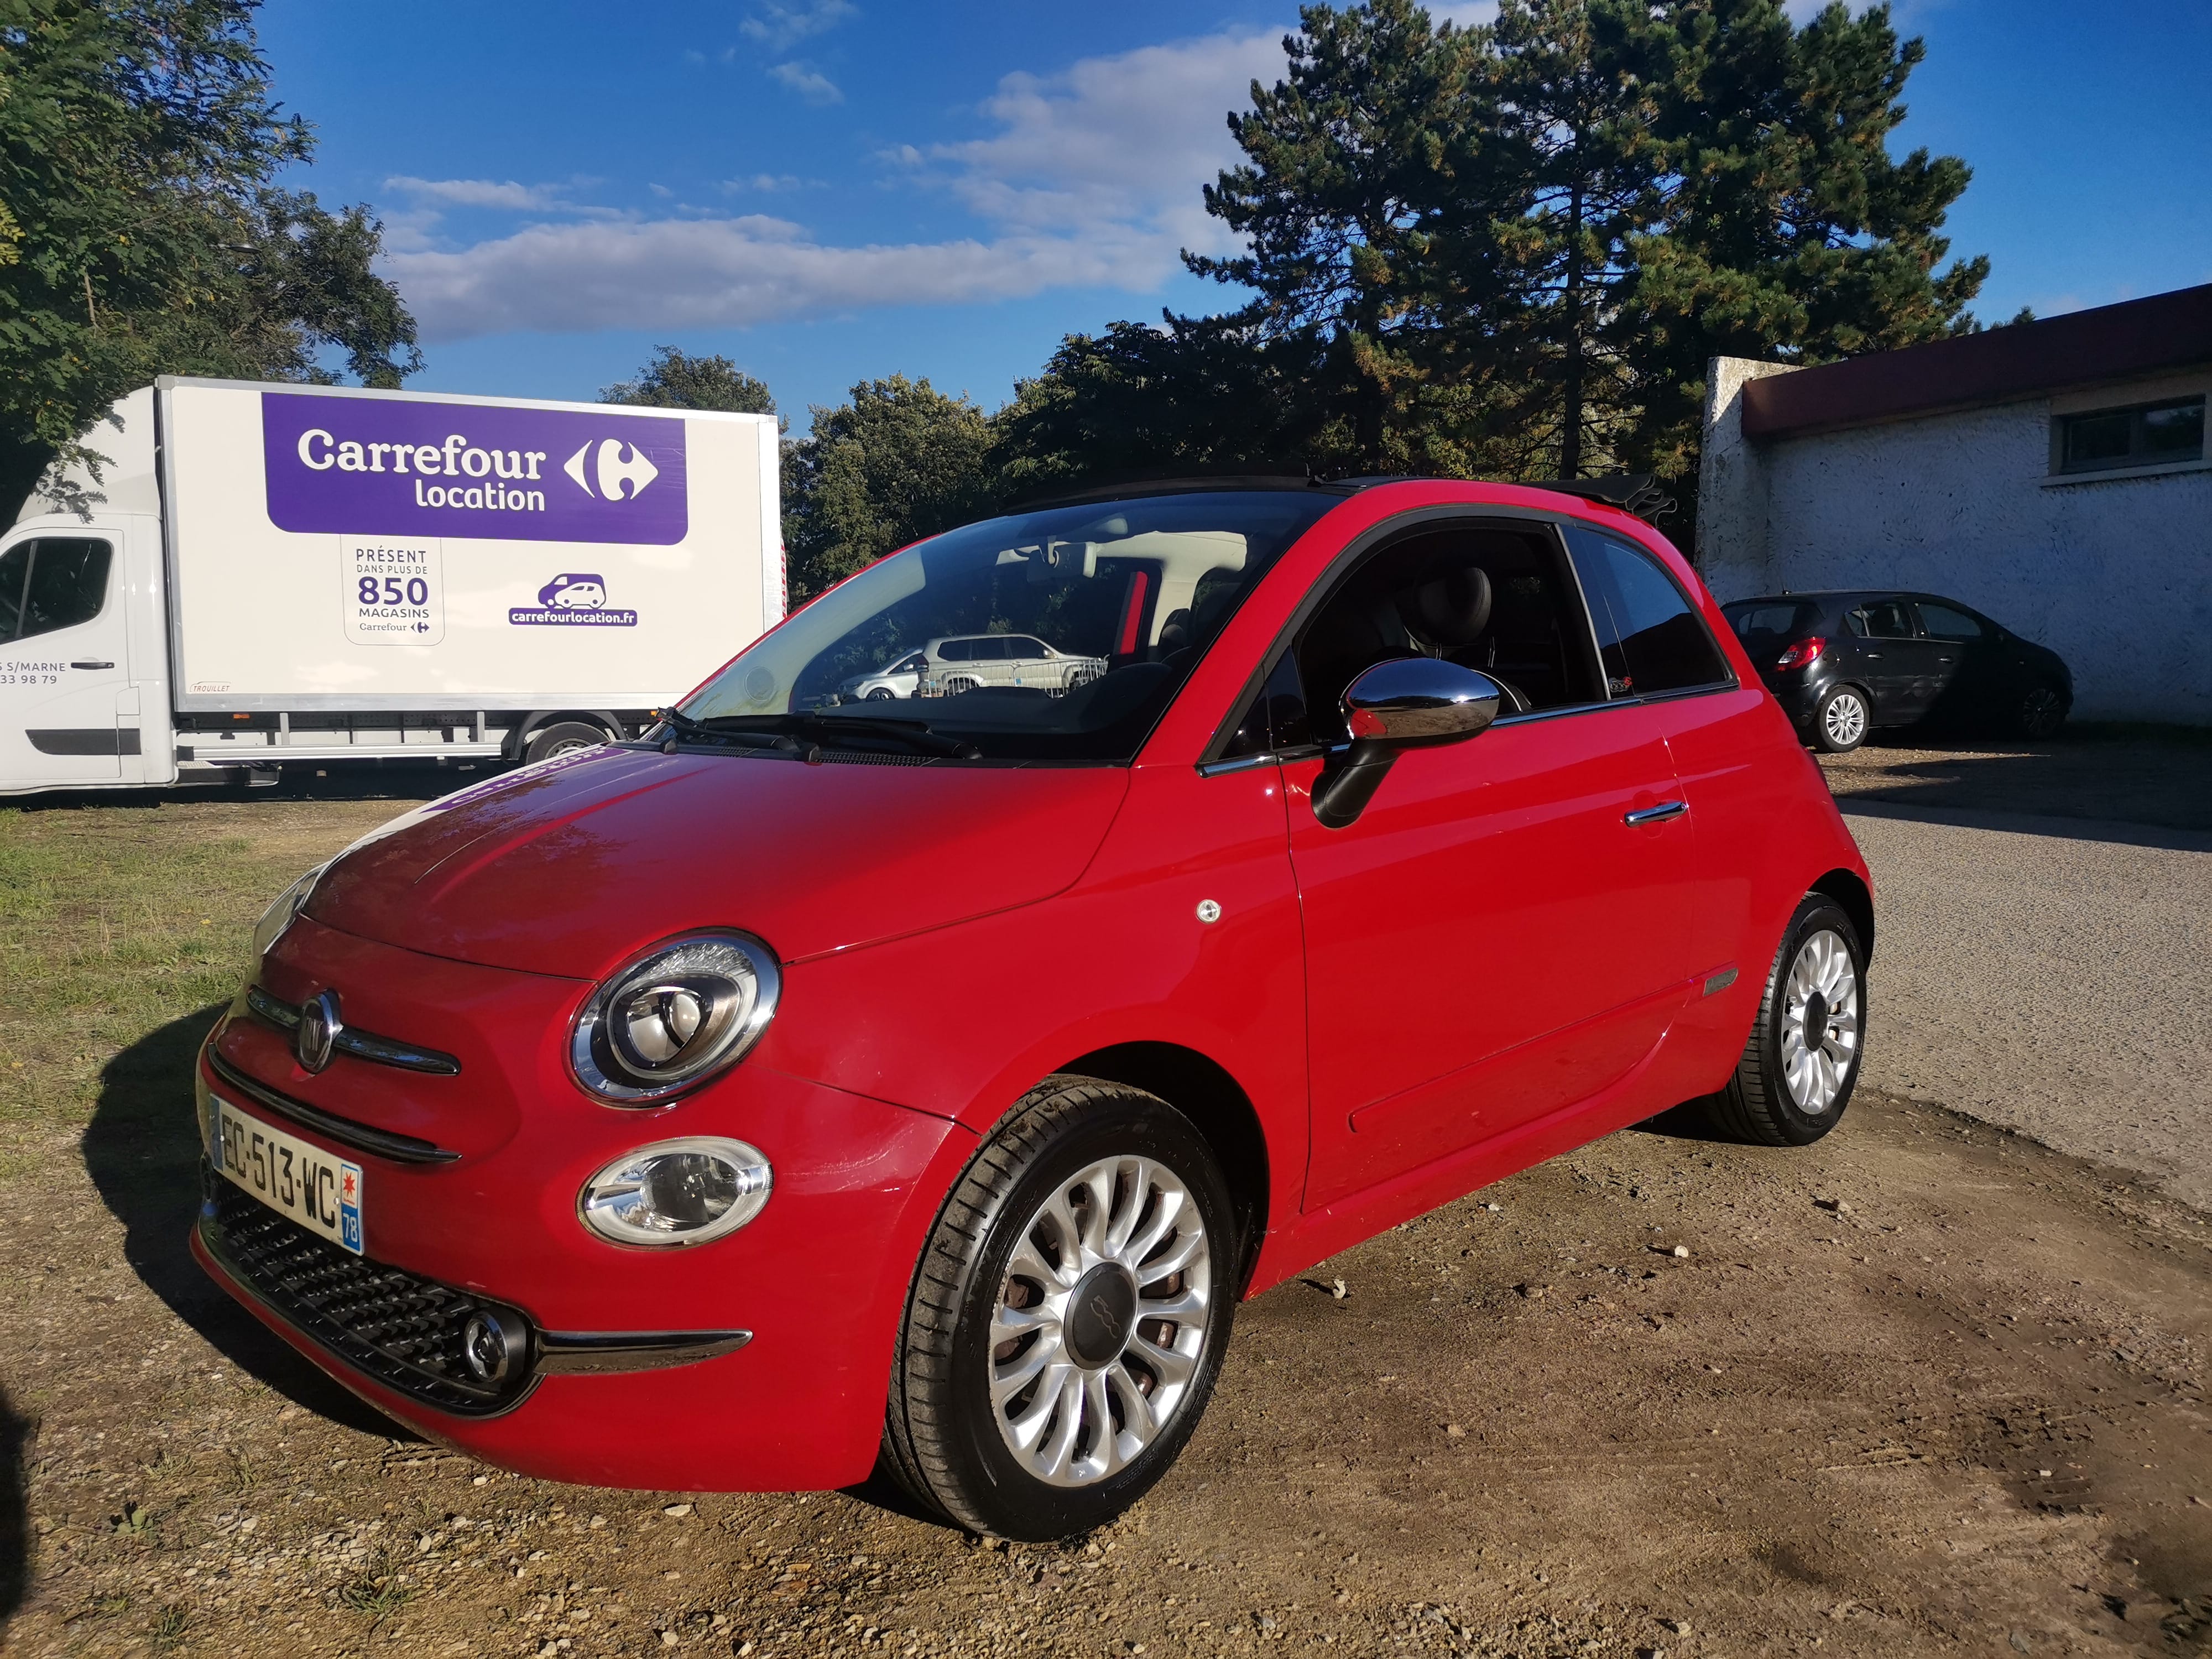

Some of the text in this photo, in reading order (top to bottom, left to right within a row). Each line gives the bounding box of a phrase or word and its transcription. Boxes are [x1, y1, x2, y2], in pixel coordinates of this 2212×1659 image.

[298, 429, 546, 480] Carrefour
[415, 479, 545, 512] location
[356, 545, 426, 564] PRÉSENT
[357, 564, 428, 575] DANS PLUS DE
[358, 576, 429, 606] 850
[359, 608, 430, 618] MAGASINS
[512, 611, 635, 624] carrefourlocation.fr
[359, 623, 407, 631] Carrefour
[7, 661, 66, 673] S/MARNE
[0, 675, 57, 684] 33 98 79
[343, 1212, 358, 1243] 78
